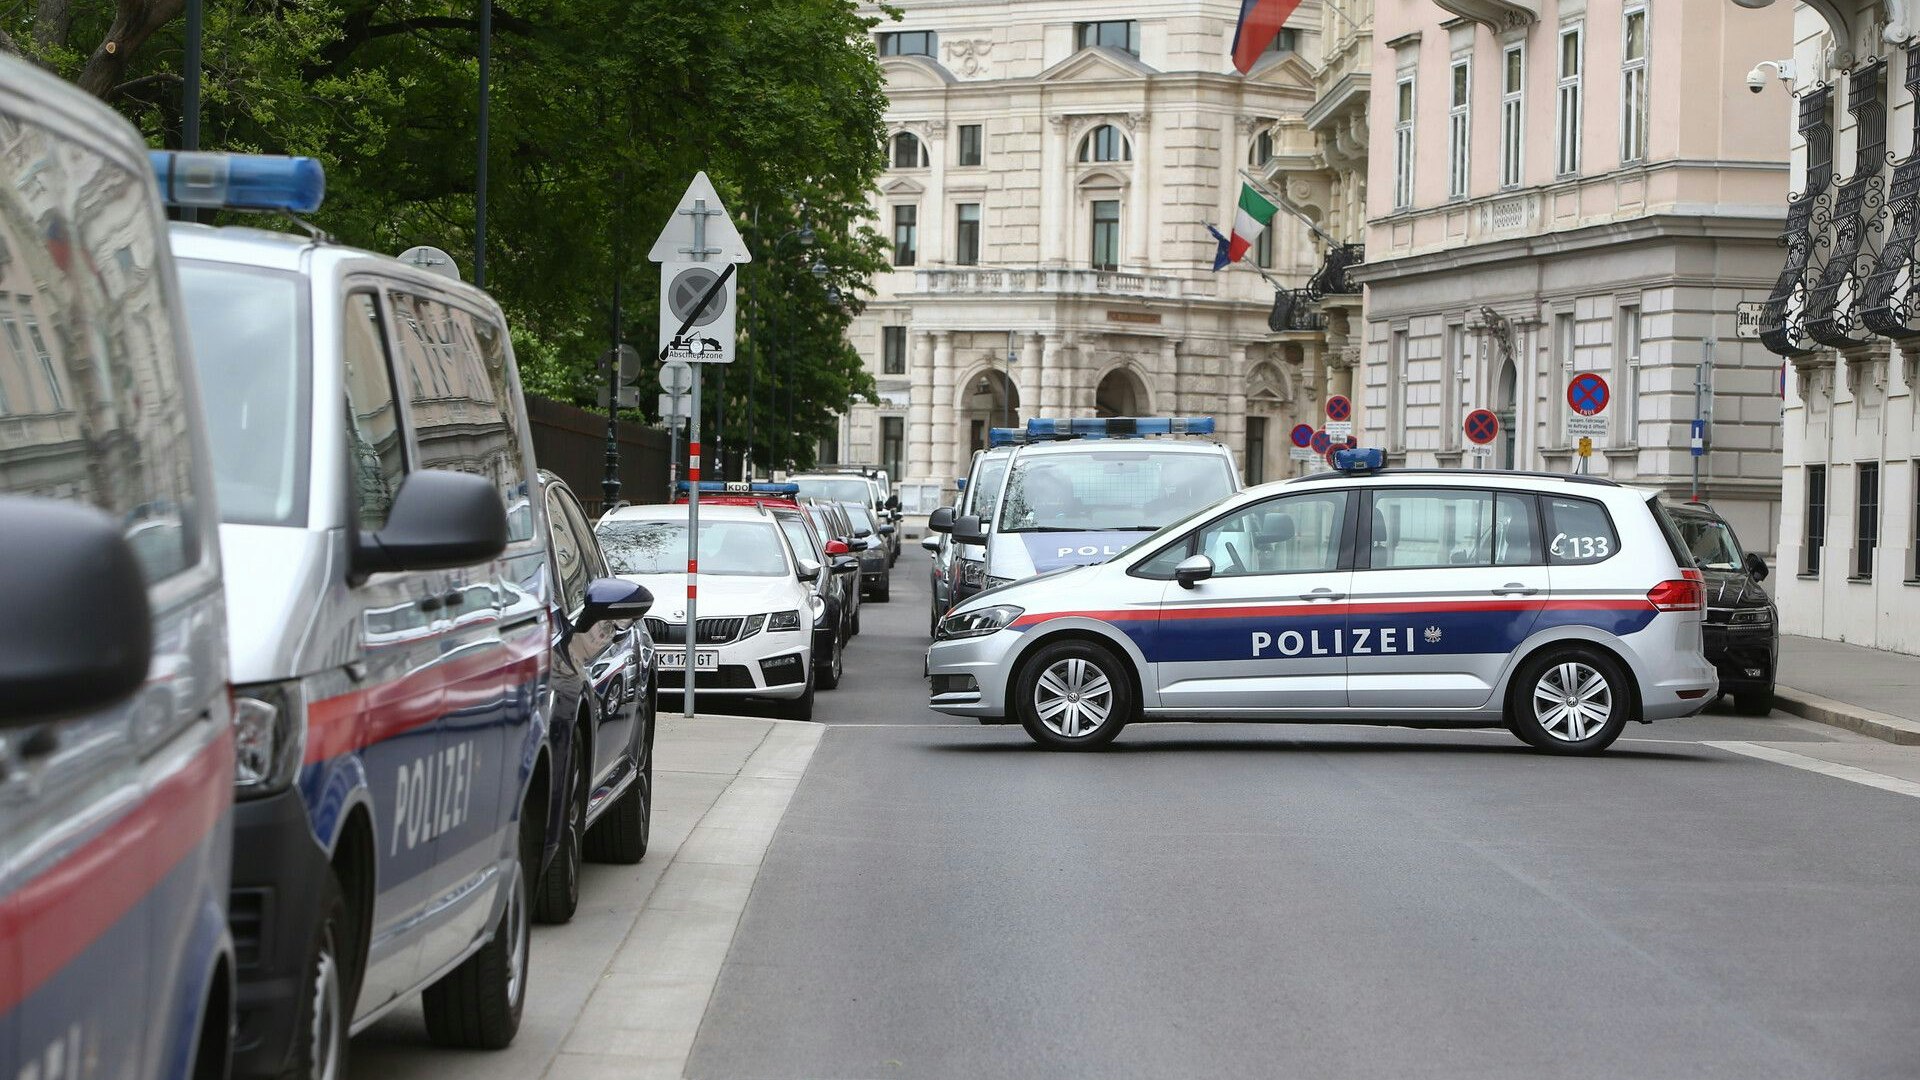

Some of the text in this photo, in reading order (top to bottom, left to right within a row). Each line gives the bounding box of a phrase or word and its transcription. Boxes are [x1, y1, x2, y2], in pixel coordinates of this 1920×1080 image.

[669, 350, 723, 360] Abschleppzone
[727, 484, 749, 492] KDO
[1569, 536, 1609, 558] 133
[1251, 627, 1415, 657] POLIZEI
[390, 740, 474, 857] POLIZEI
